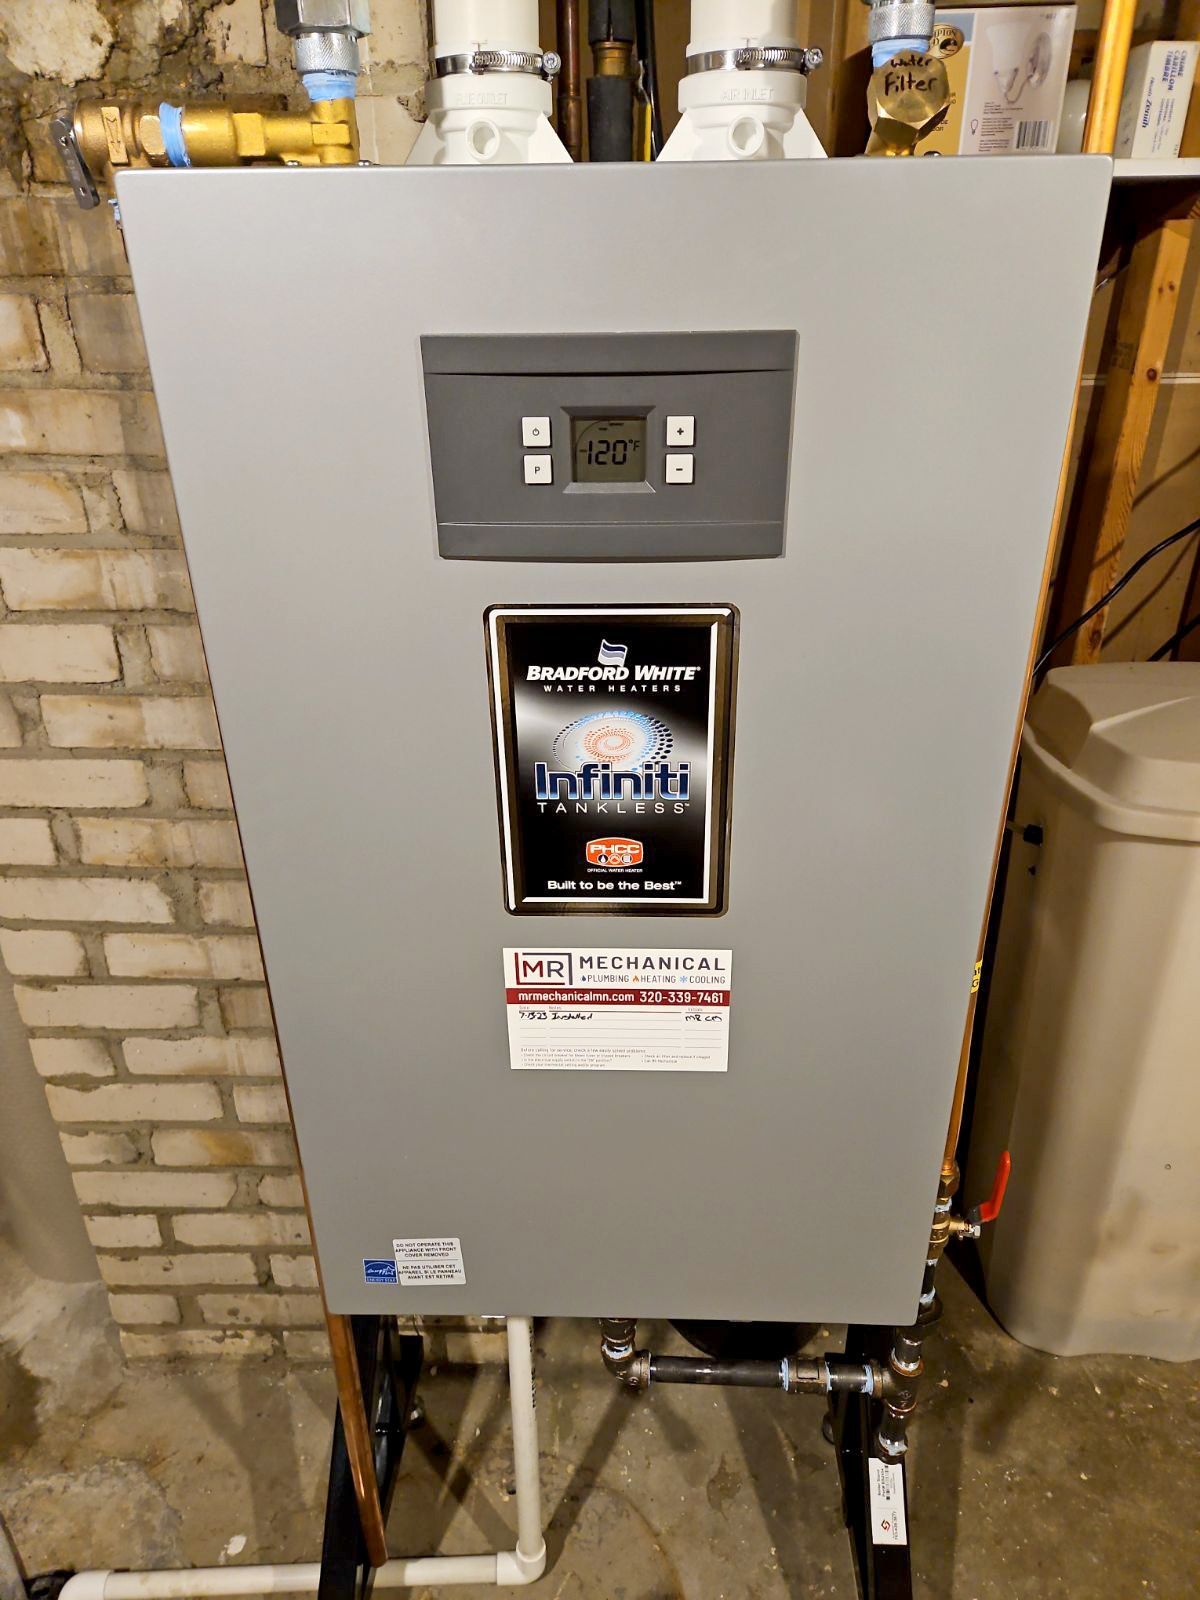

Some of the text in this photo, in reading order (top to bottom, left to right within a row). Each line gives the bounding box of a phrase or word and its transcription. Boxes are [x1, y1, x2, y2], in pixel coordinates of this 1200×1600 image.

[884, 72, 938, 96] Filter
[534, 466, 541, 475] P
[526, 665, 629, 681] BRADFORD
[543, 684, 681, 692] WATER HEATERS
[534, 761, 691, 800] Infiniti
[589, 844, 640, 854] PHCC
[547, 880, 576, 890] Built
[579, 880, 594, 890] to
[597, 880, 614, 890] be
[618, 880, 640, 890] the
[523, 956, 726, 978] MR MECHANICAL
[587, 974, 726, 984] PLUMBING HEATING COOLING
[518, 990, 724, 1004] mrmechanicalmn.com 320-339-7461
